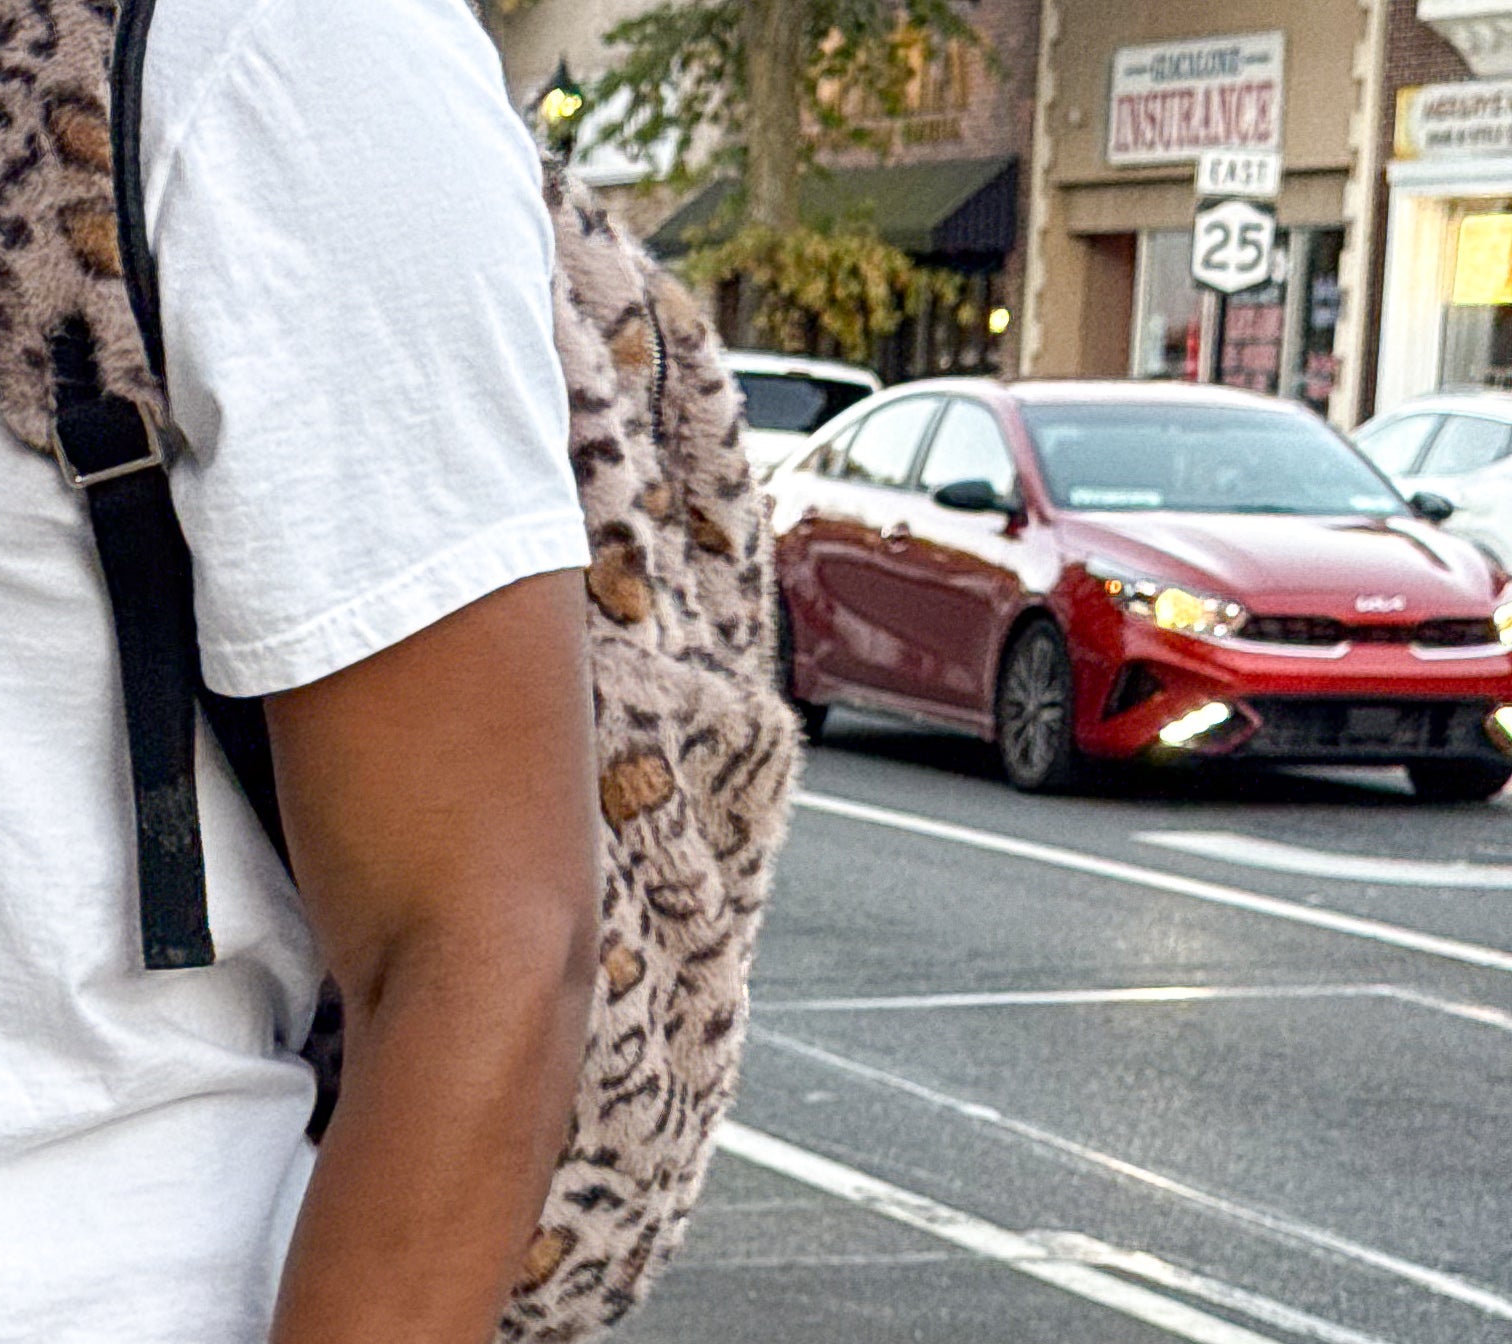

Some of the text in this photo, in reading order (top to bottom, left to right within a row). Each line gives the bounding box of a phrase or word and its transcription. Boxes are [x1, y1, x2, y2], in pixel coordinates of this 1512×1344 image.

[1112, 79, 1274, 152] INSURANCE
[1210, 158, 1268, 187] EAST
[1201, 221, 1264, 271] 25
